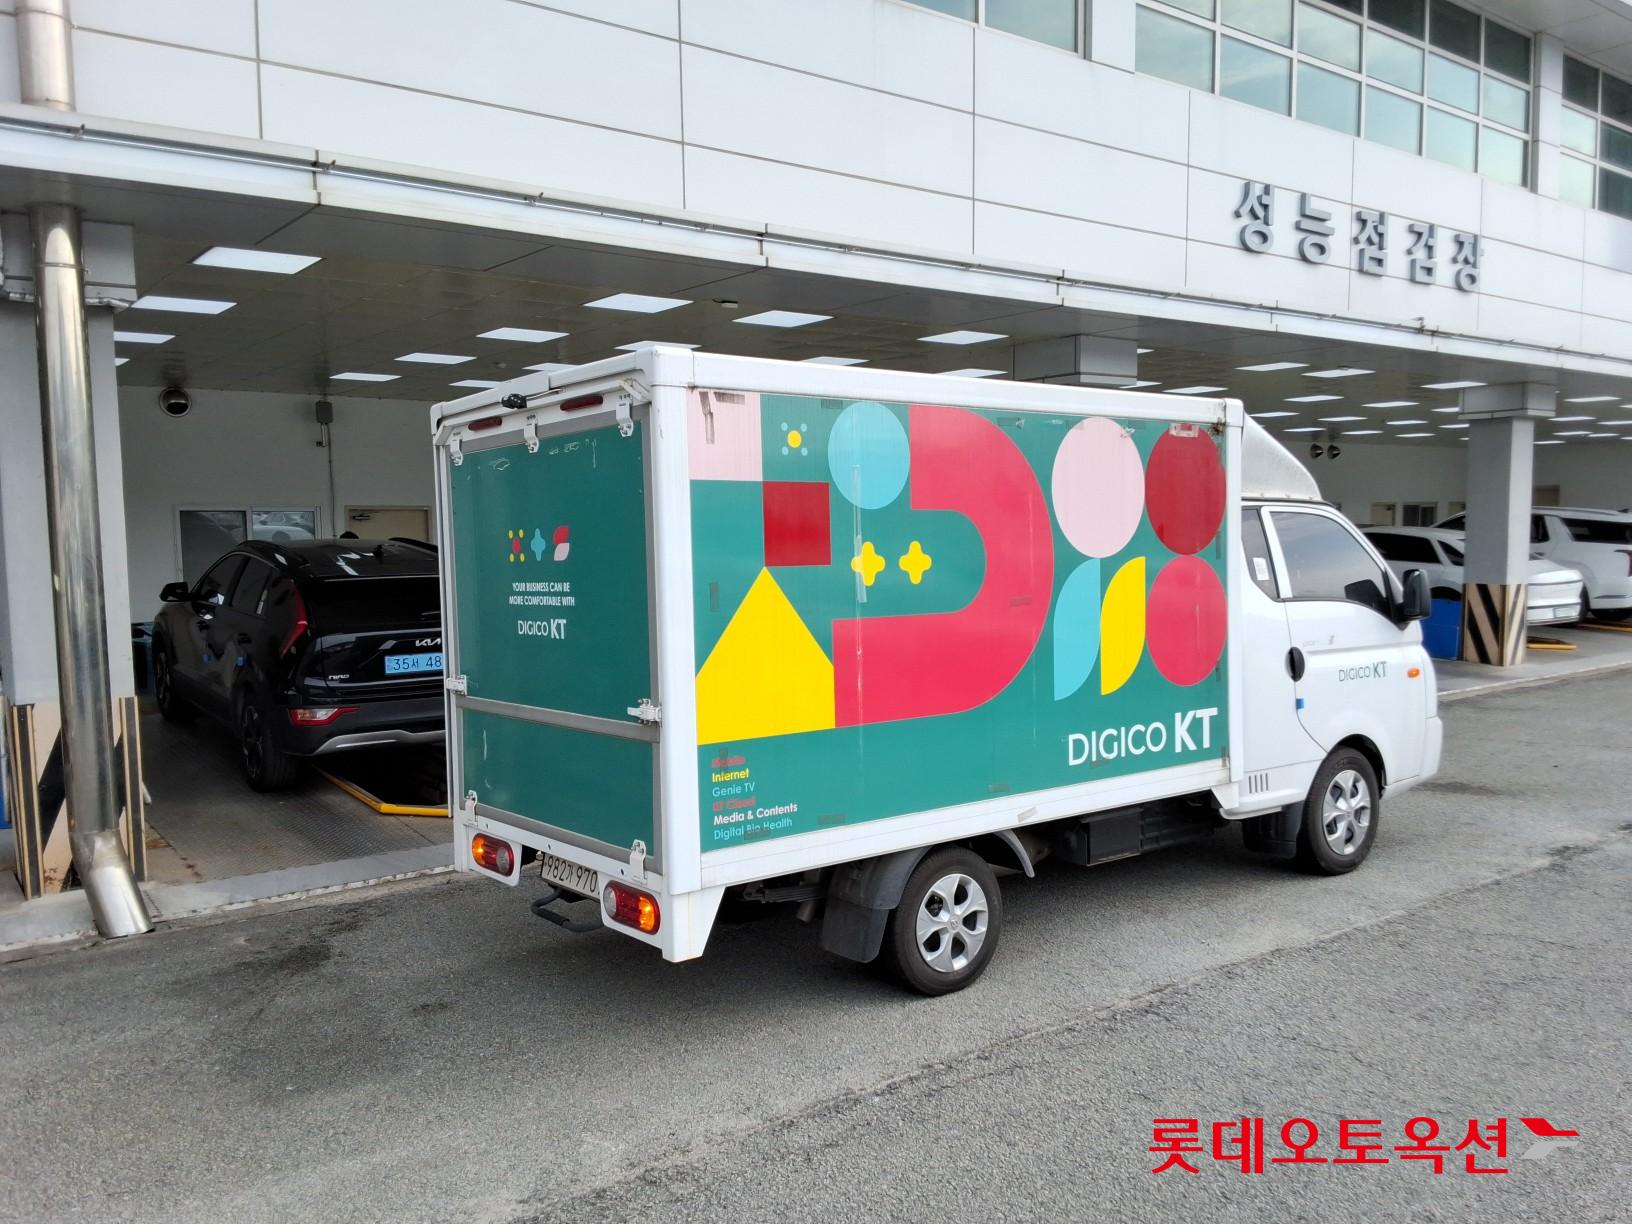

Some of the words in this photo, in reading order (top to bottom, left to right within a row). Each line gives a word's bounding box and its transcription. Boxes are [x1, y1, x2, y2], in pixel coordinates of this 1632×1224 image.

[1233, 180, 1484, 292] 성능점검장
[512, 582, 526, 592] YOUR
[526, 582, 549, 592] BUSINESS
[549, 582, 562, 592] CAN
[563, 582, 571, 592] BE
[509, 595, 524, 605] MORE
[523, 596, 561, 606] COMFORTABLE
[562, 596, 575, 606] WITH
[517, 620, 549, 636] DIGICO
[550, 618, 567, 640] KT
[393, 657, 420, 671] 35서
[1338, 665, 1371, 682] DIGICO
[1372, 660, 1387, 679] KT
[1067, 721, 1168, 767] DIGICO
[1174, 707, 1219, 753] KT
[711, 768, 750, 783] Internet
[712, 785, 742, 797] Genie
[744, 781, 756, 793] TV
[713, 812, 745, 826] Media
[747, 810, 754, 820] &
[756, 803, 798, 818] Contents
[713, 826, 745, 841] Digital
[763, 817, 793, 831] Health
[575, 865, 600, 895] 970
